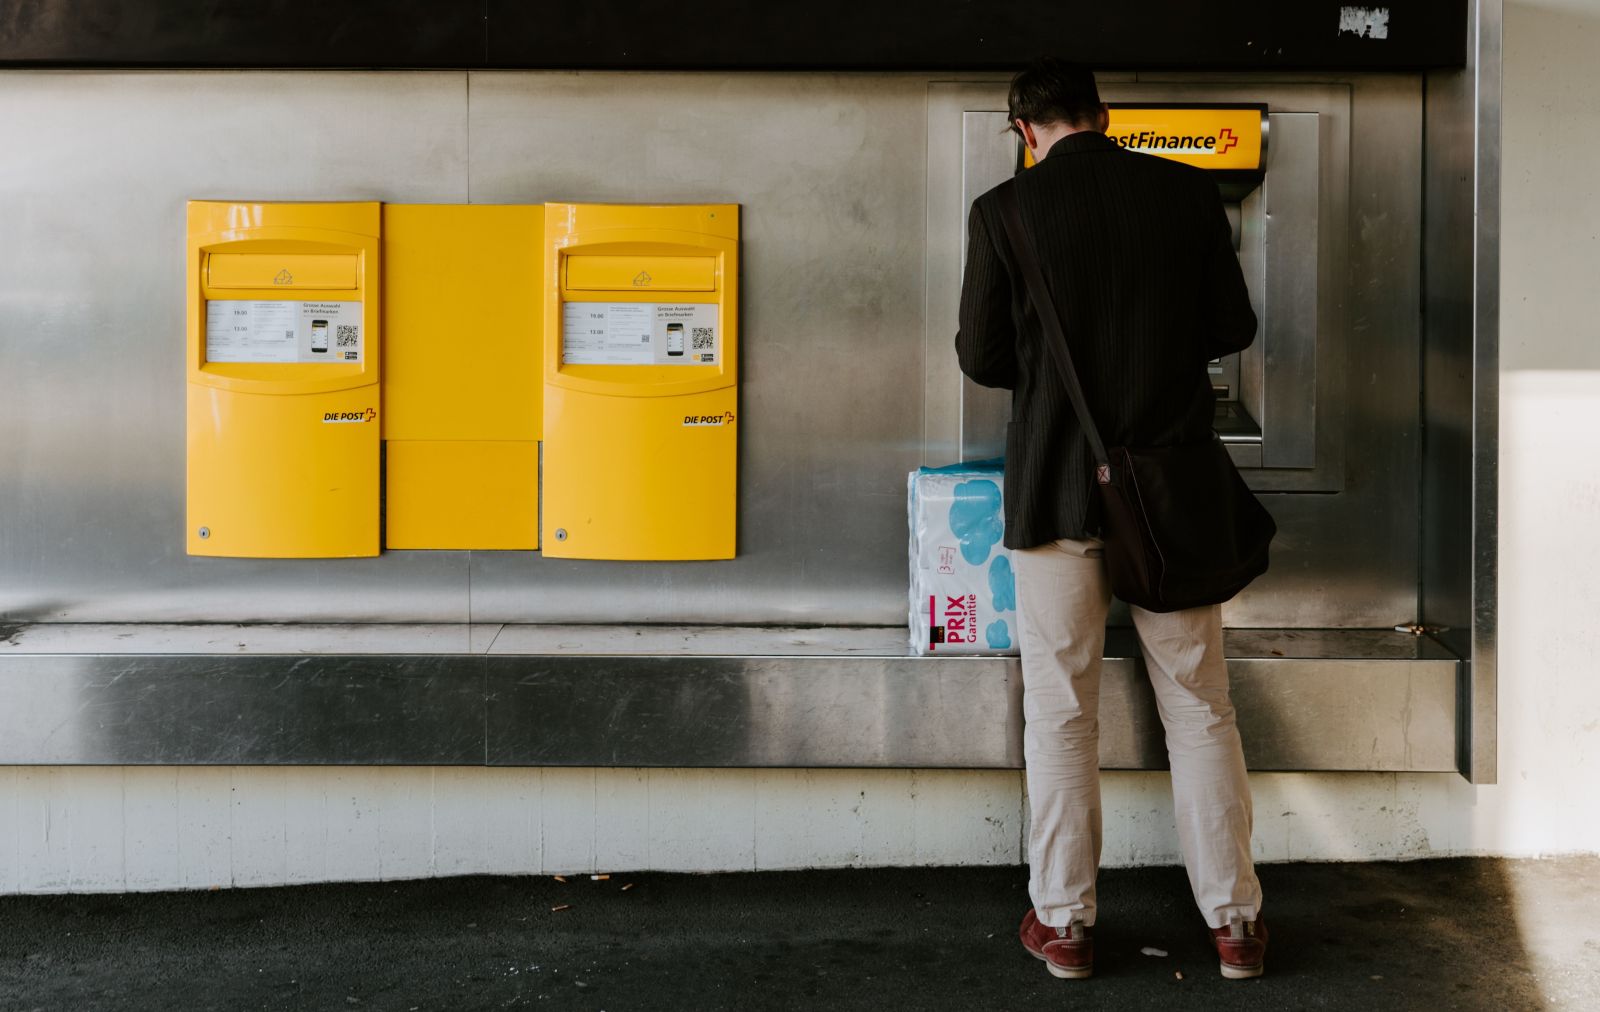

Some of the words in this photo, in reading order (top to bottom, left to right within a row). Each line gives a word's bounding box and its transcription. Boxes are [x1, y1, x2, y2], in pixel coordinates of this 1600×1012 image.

[1107, 131, 1216, 149] ostFinance
[324, 412, 339, 420] DIE
[340, 412, 365, 420] POST
[684, 415, 699, 424] DIE
[700, 415, 723, 424] POST
[967, 594, 977, 643] Garantie
